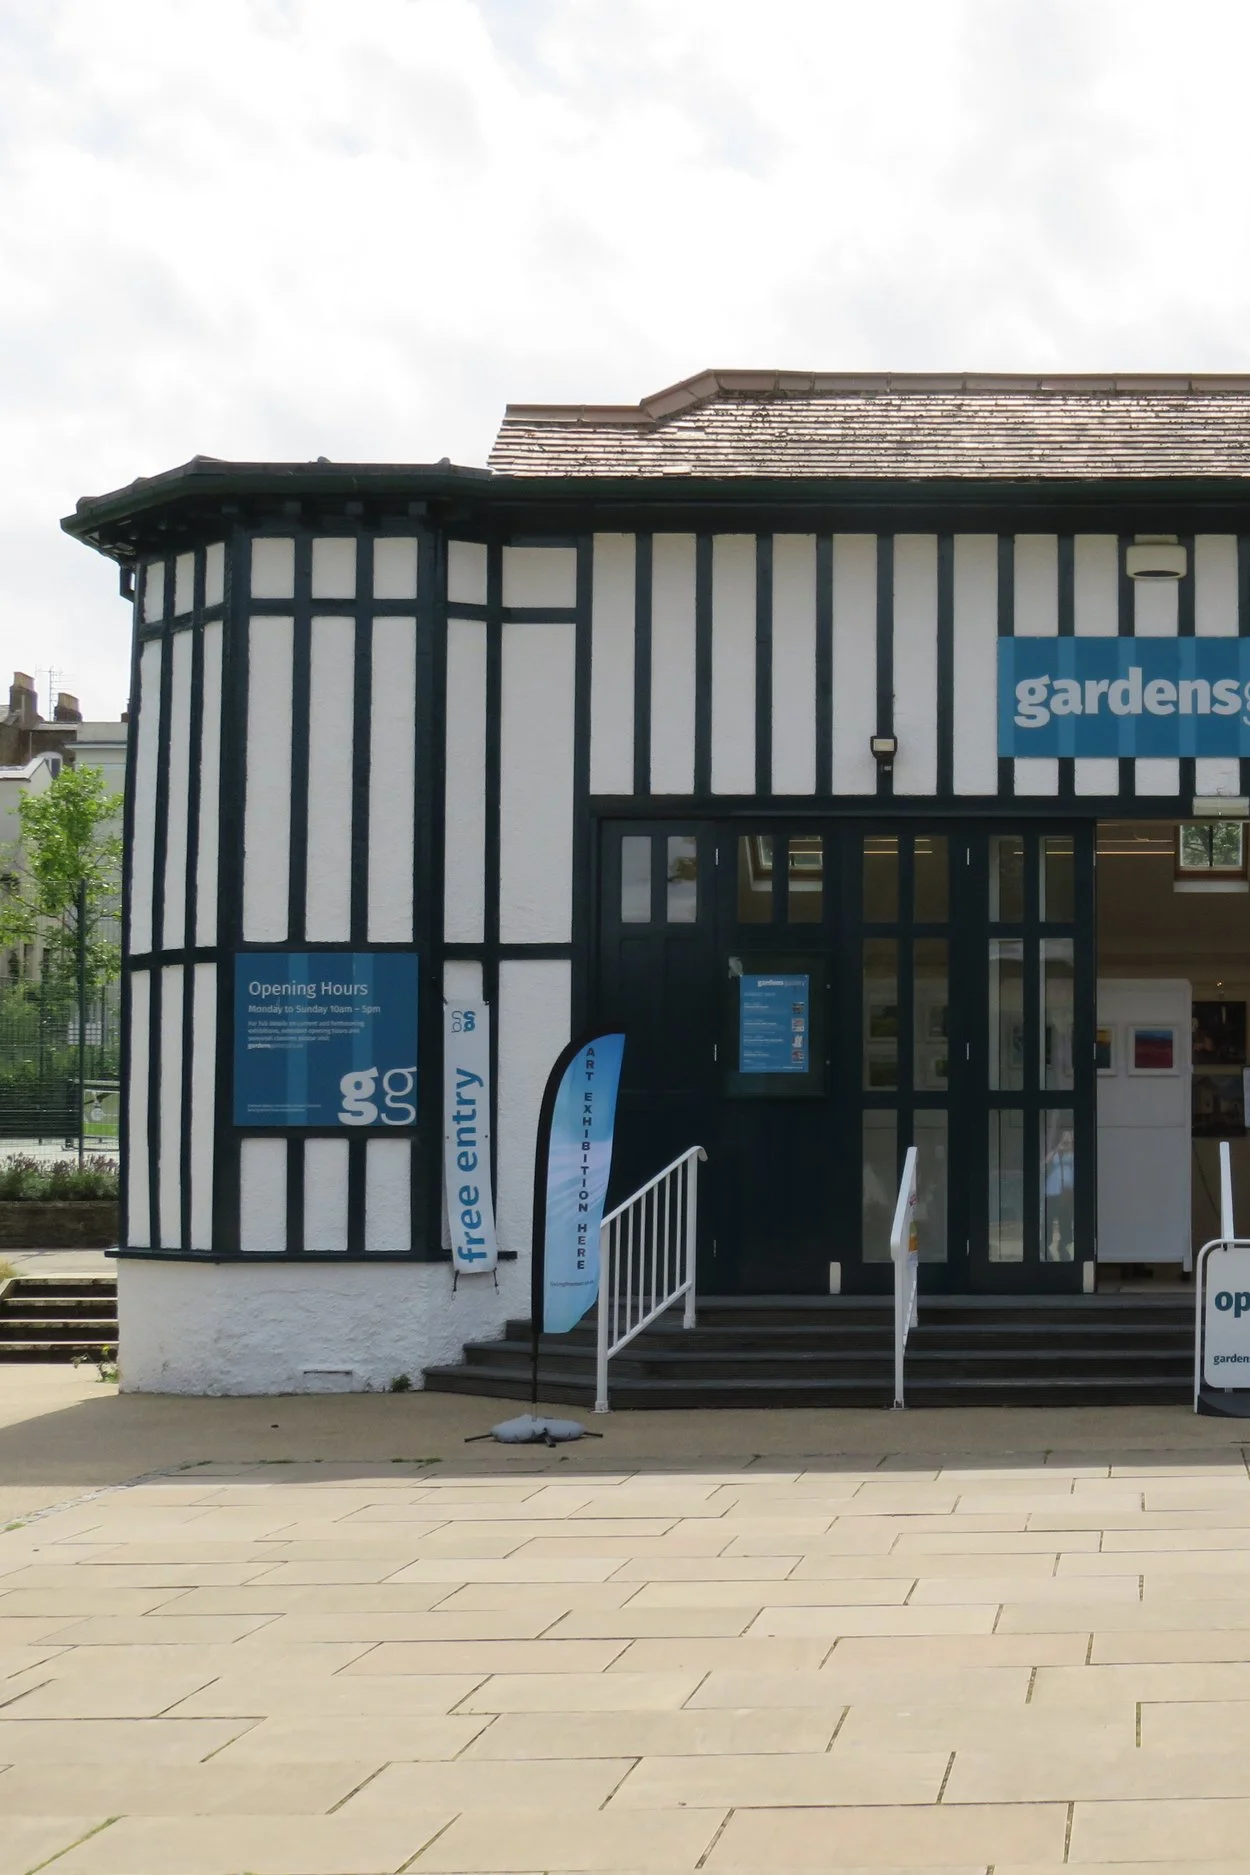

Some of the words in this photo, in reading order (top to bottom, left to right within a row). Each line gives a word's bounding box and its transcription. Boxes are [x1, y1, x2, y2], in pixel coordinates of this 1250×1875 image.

[248, 980, 316, 998] Opening
[321, 981, 369, 995] Hours
[248, 1004, 284, 1015] Monday
[285, 1005, 294, 1013] to
[296, 1004, 328, 1015] Sunday
[330, 1004, 352, 1013] 10am
[361, 1005, 381, 1015] 5pm
[585, 1046, 596, 1082] ART
[337, 1066, 417, 1126] gg
[451, 1067, 485, 1172] entry
[579, 1091, 594, 1213] EXHIBITION
[457, 1184, 489, 1264] free
[576, 1222, 588, 1270] HERE
